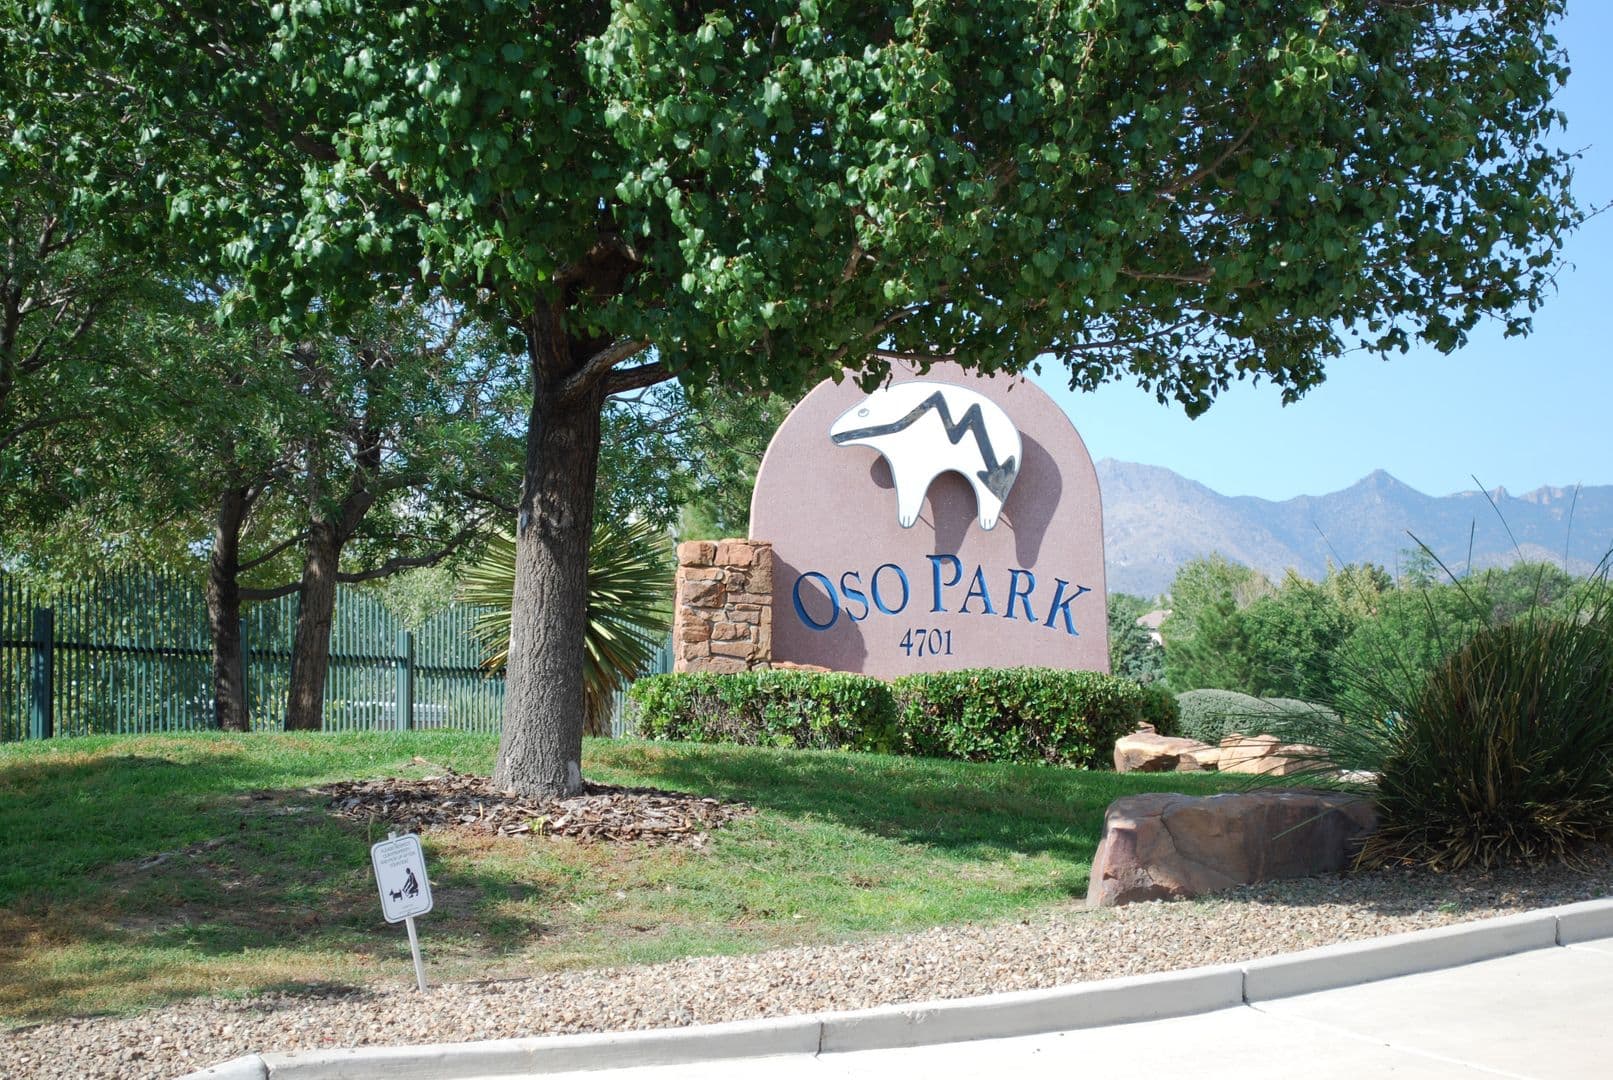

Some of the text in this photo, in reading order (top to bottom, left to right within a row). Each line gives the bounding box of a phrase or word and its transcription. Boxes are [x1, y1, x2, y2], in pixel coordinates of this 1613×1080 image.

[792, 554, 1092, 636] OSO PARK
[899, 628, 953, 656] 4701
